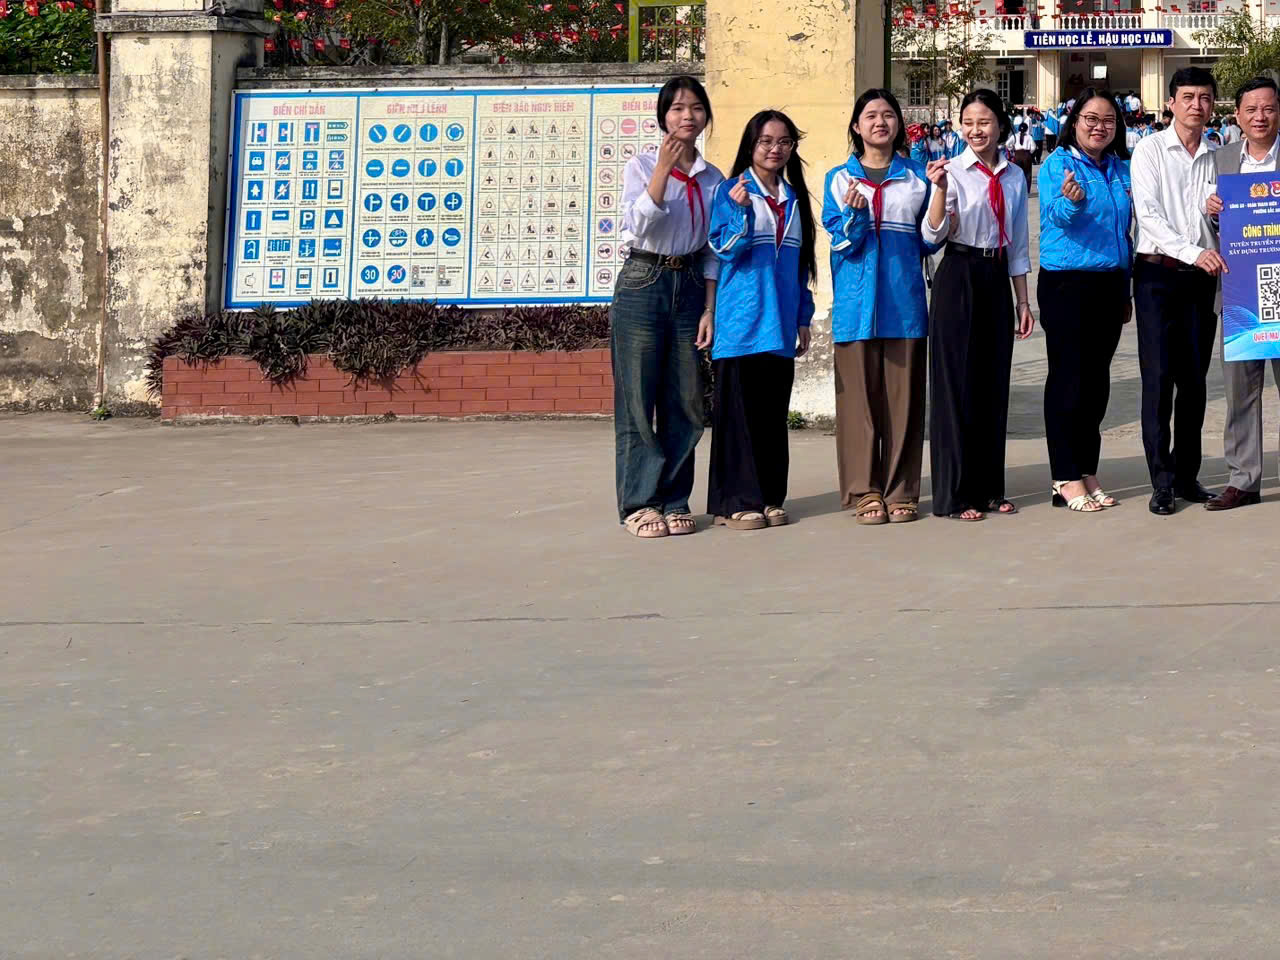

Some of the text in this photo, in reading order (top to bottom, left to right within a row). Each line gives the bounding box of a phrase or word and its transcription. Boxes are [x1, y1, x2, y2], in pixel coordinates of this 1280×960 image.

[1033, 33, 1056, 46] TIÊN
[1058, 34, 1079, 47] HỌC
[1098, 32, 1119, 47] HẬU
[1121, 33, 1141, 47] HỌC
[1143, 32, 1165, 44] VĂN
[1243, 223, 1262, 238] CÔNG
[365, 269, 376, 280] 30
